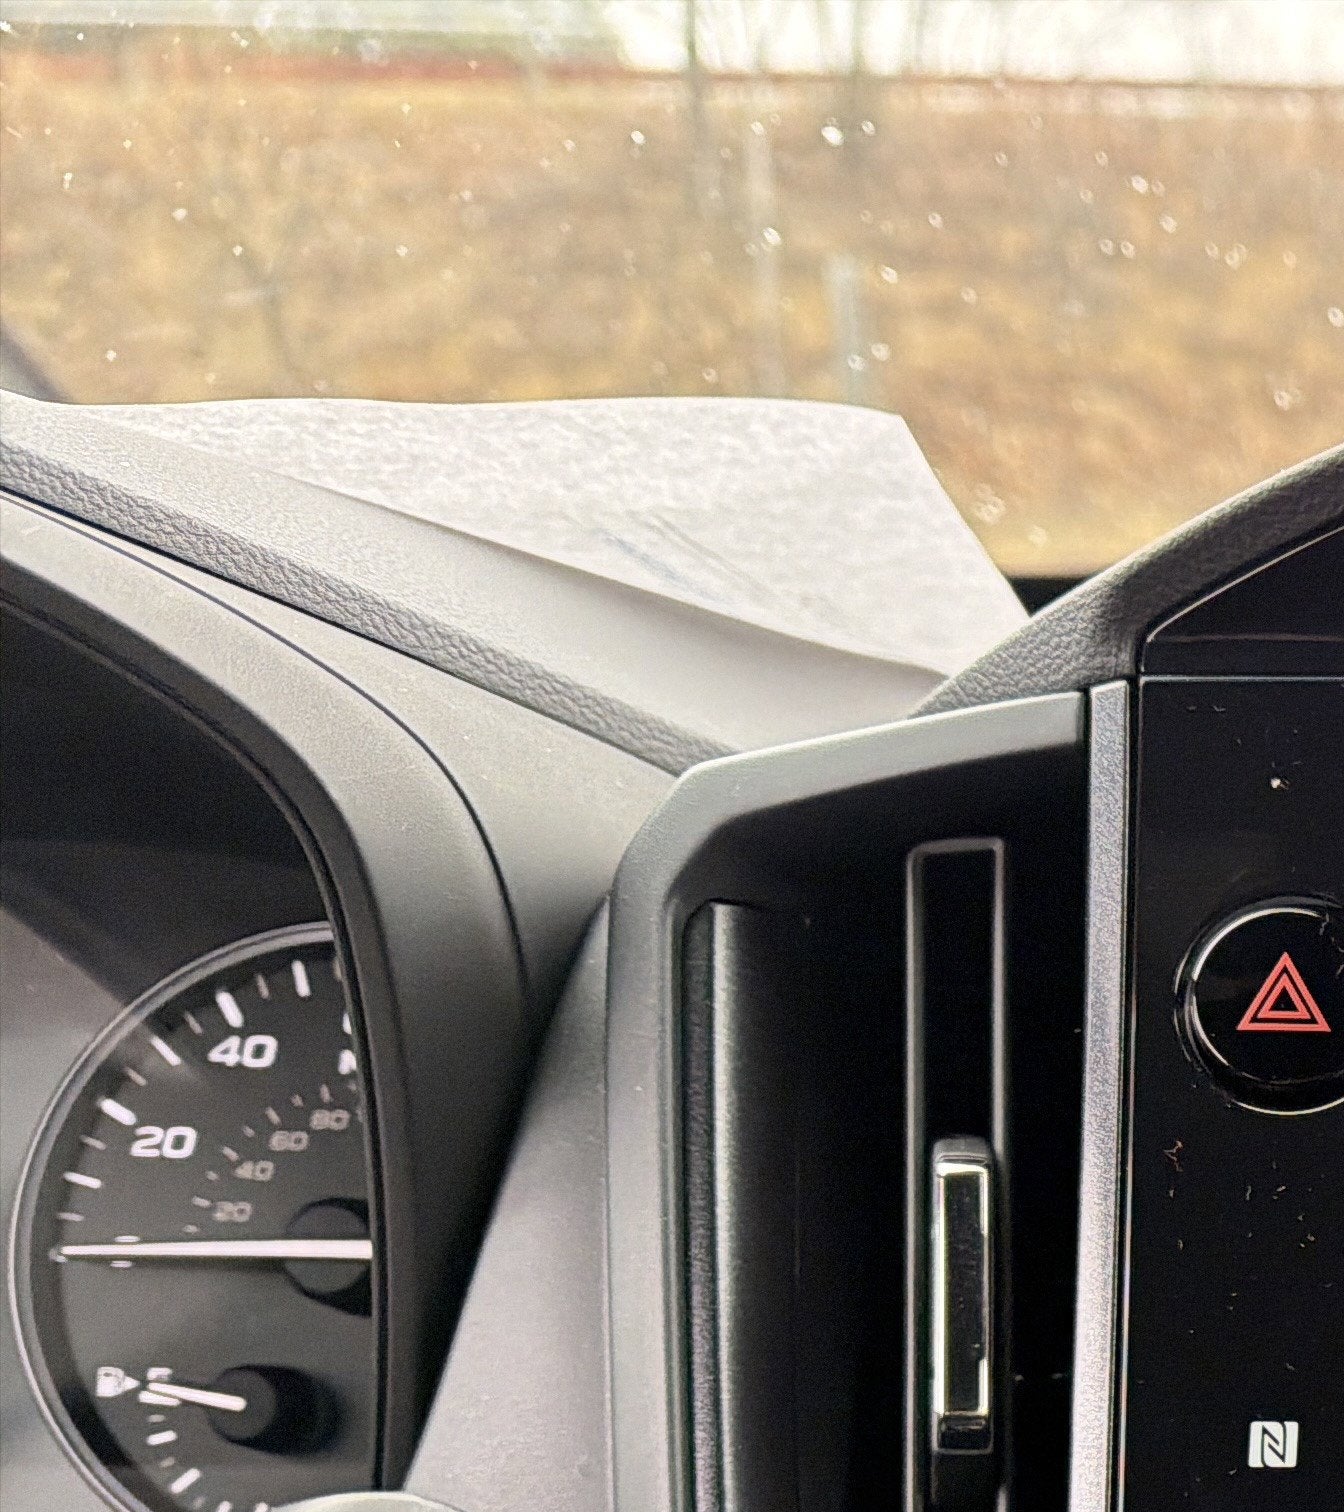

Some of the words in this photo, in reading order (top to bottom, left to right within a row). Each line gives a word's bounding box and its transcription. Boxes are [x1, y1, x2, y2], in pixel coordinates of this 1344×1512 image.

[207, 1034, 278, 1068] 40
[129, 1125, 198, 1159] 20
[234, 1160, 275, 1182] 40
